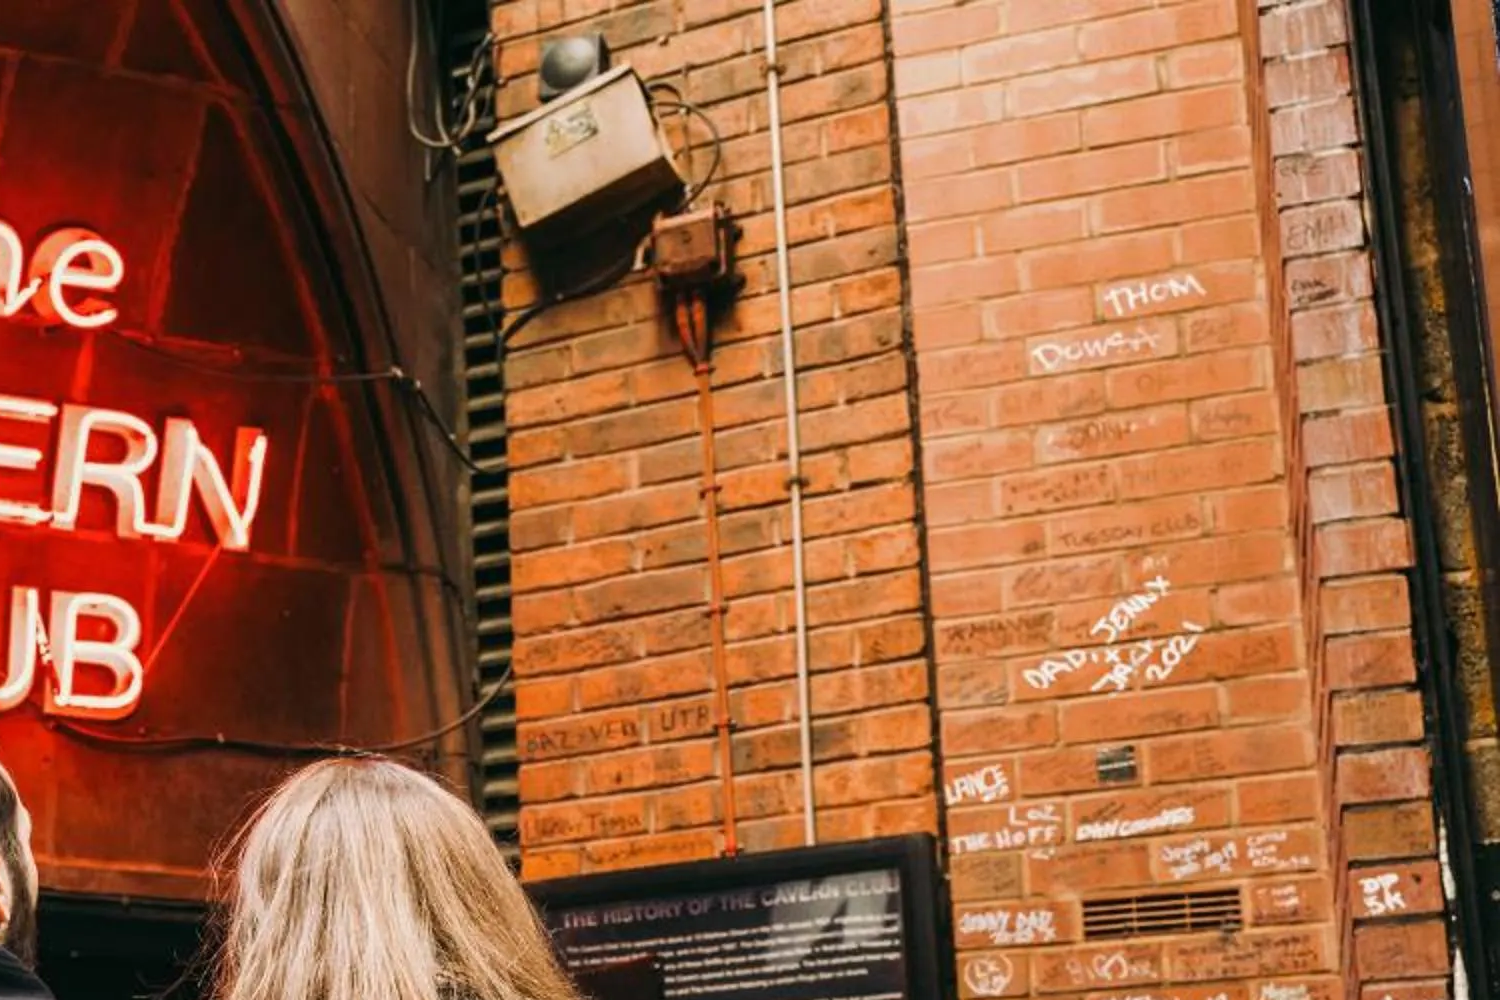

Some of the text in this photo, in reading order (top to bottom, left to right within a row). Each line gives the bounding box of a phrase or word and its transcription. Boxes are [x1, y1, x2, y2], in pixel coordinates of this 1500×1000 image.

[1104, 274, 1207, 317] THOM
[563, 911, 598, 928] THE
[603, 903, 685, 925] HISTORY
[688, 898, 710, 916] OF
[720, 892, 756, 911] THE
